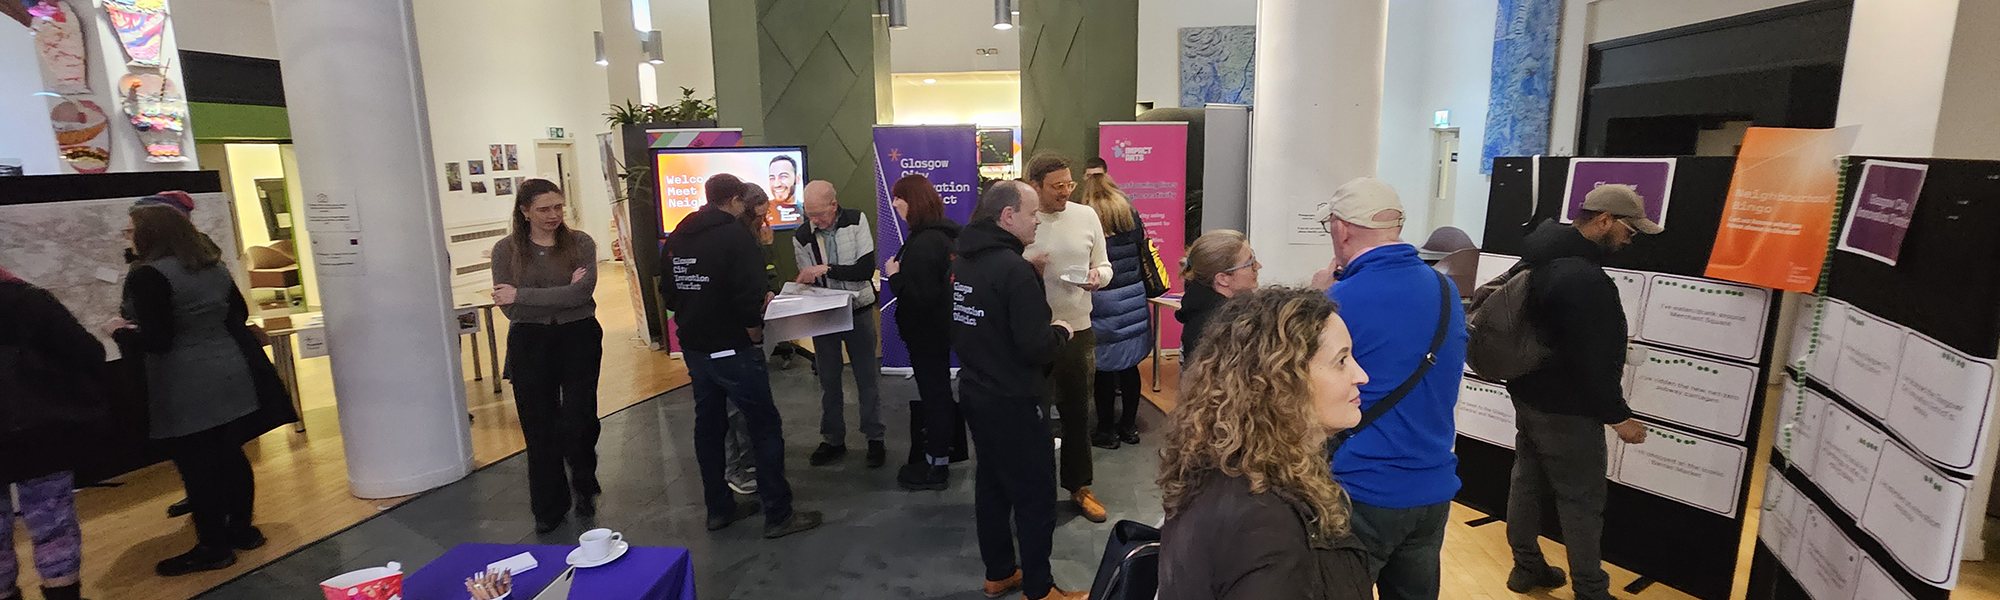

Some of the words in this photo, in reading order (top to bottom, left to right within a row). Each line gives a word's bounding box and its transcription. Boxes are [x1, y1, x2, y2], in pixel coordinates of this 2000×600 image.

[900, 158, 949, 170] Glasgow
[666, 174, 704, 184] Welco
[667, 186, 698, 196] Meet
[1732, 201, 1773, 214] Bingo
